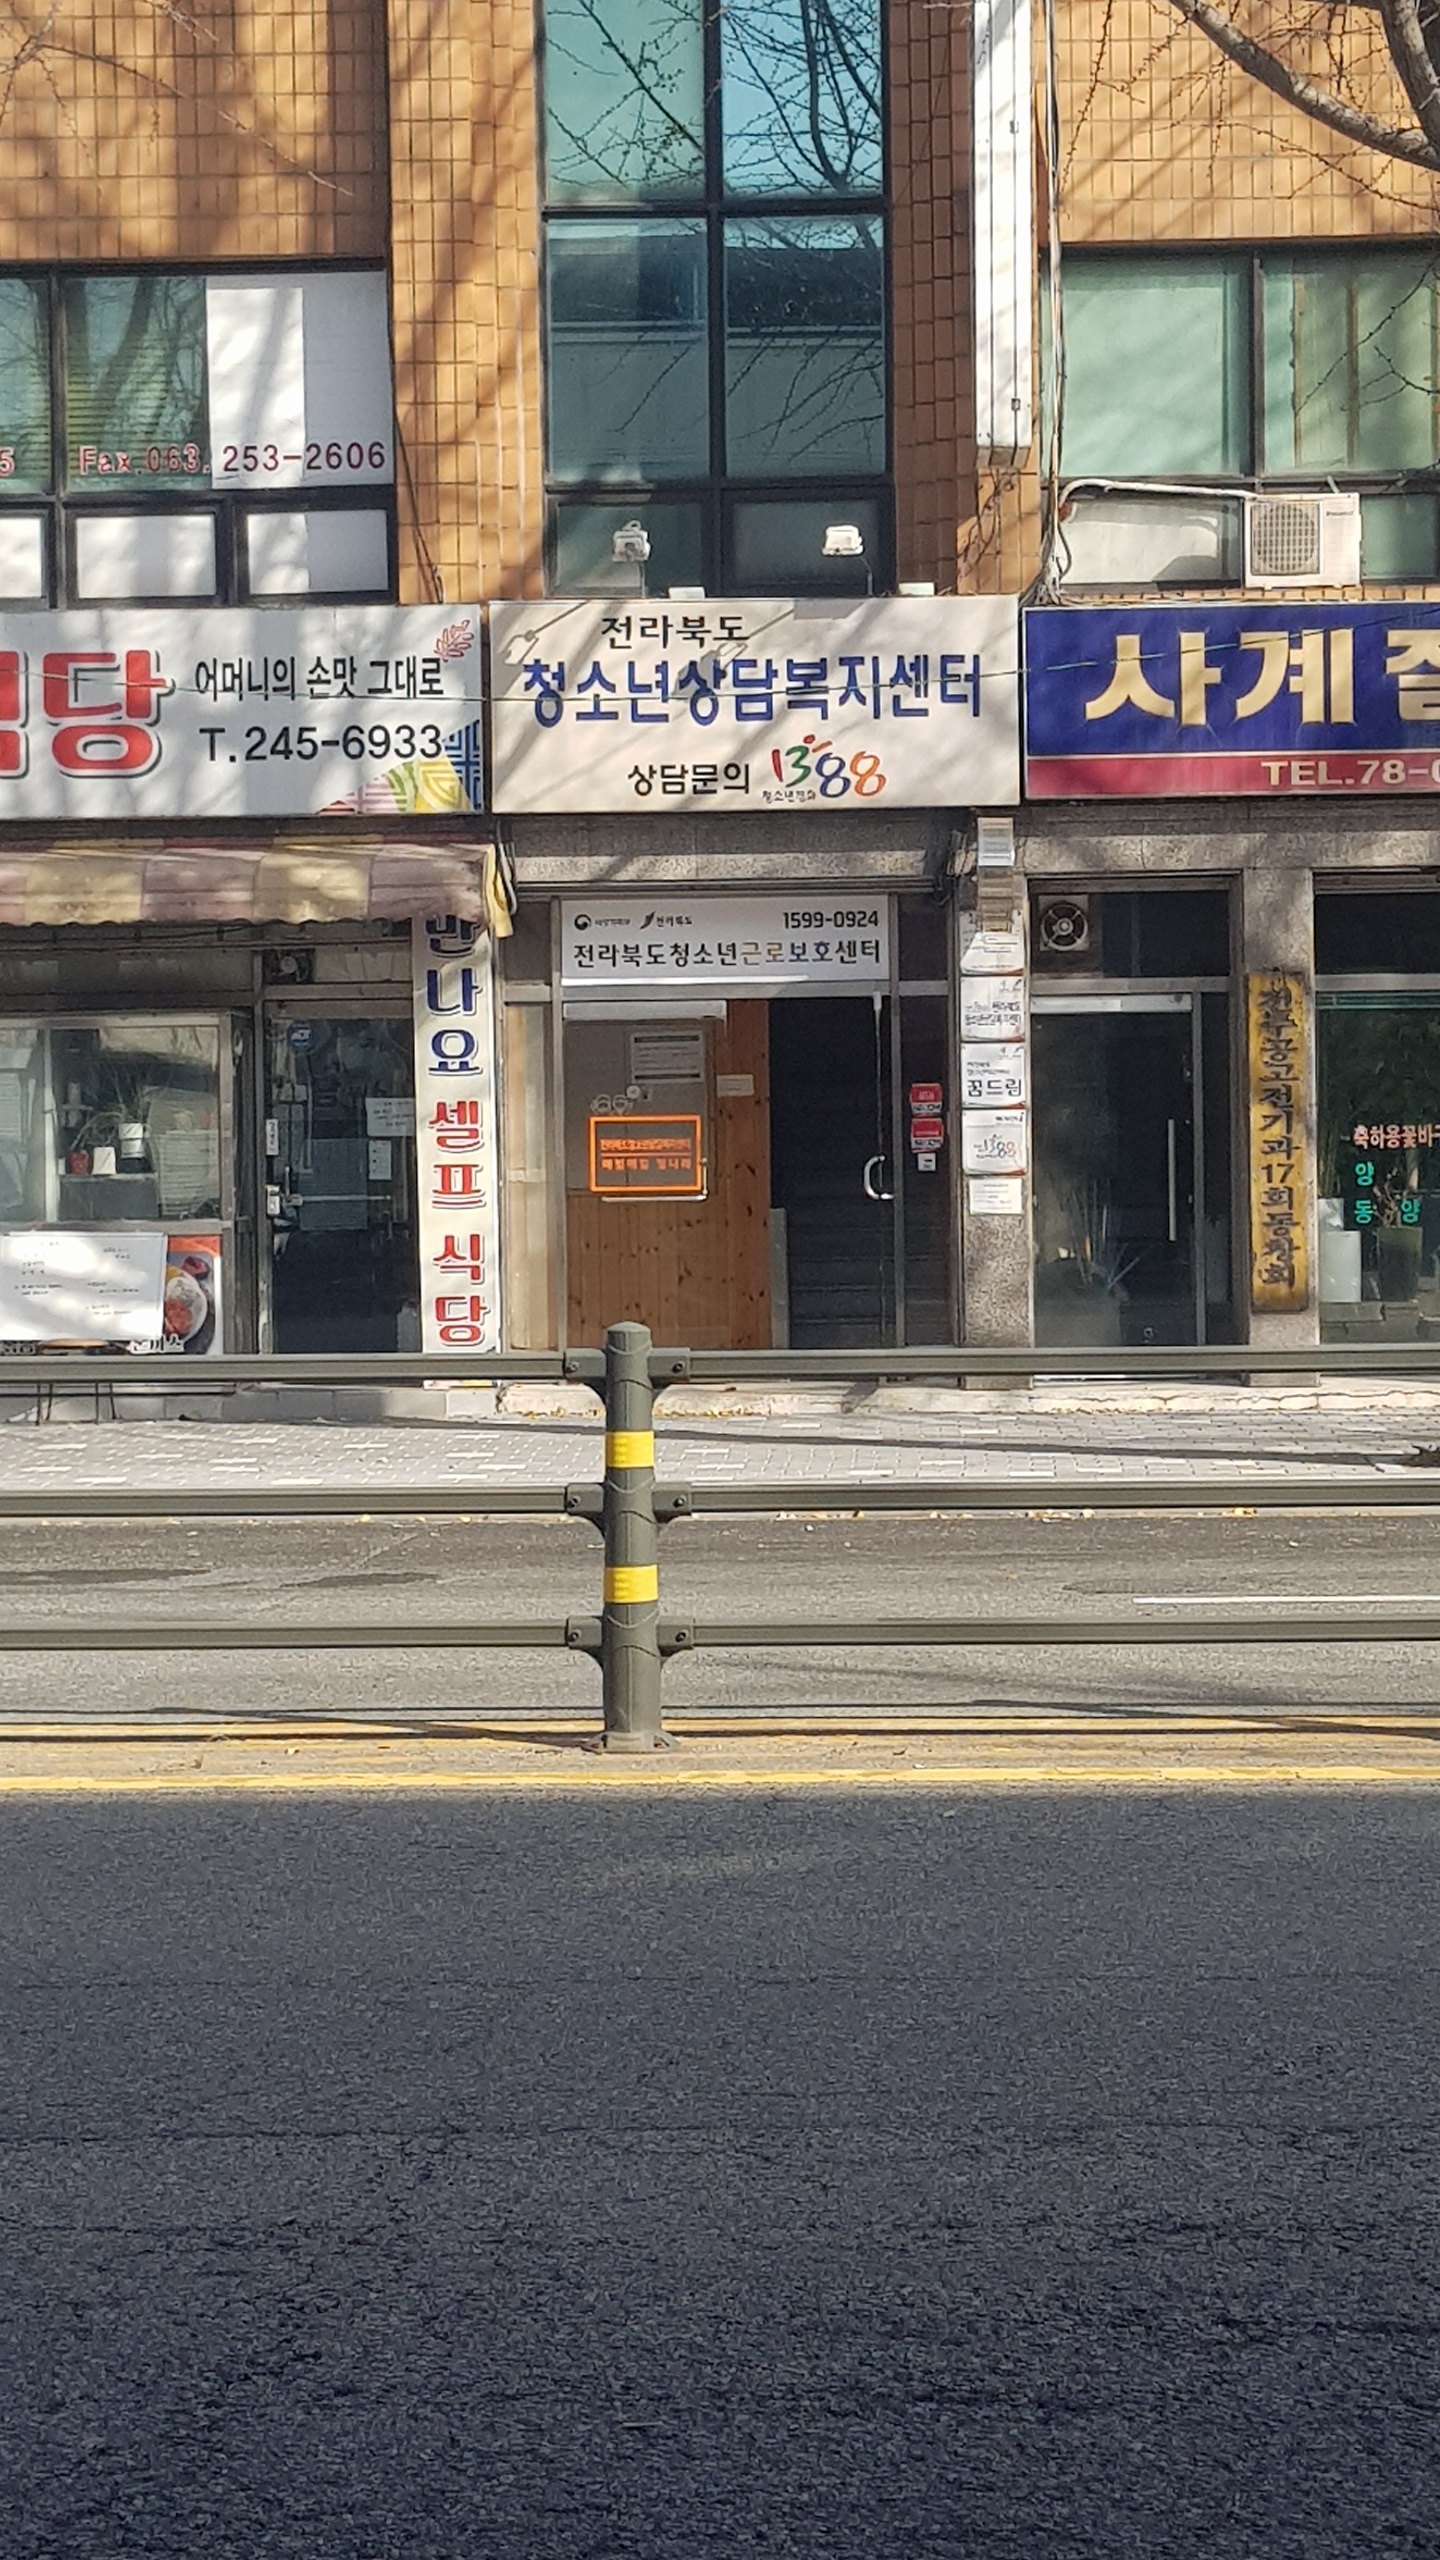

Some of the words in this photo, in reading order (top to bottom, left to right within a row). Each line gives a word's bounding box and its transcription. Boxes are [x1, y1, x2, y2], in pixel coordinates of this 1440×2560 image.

[600, 614, 751, 649] 전라북도
[195, 656, 296, 701] 어머니의
[306, 653, 358, 699] 손맛
[367, 656, 445, 698] 그대로
[523, 653, 982, 728] 청소년상담복지센터
[0, 649, 175, 778] 당
[199, 724, 442, 764] T.245-6933
[628, 762, 751, 796] 상담문의
[771, 734, 886, 798] 1388
[783, 911, 879, 929] 1599-0924
[573, 940, 881, 968] 전라북도청소년근로보호센터
[967, 1079, 1021, 1097] 꿈드림
[429, 1100, 485, 1209] 셀프
[432, 1233, 490, 1347] 식당
